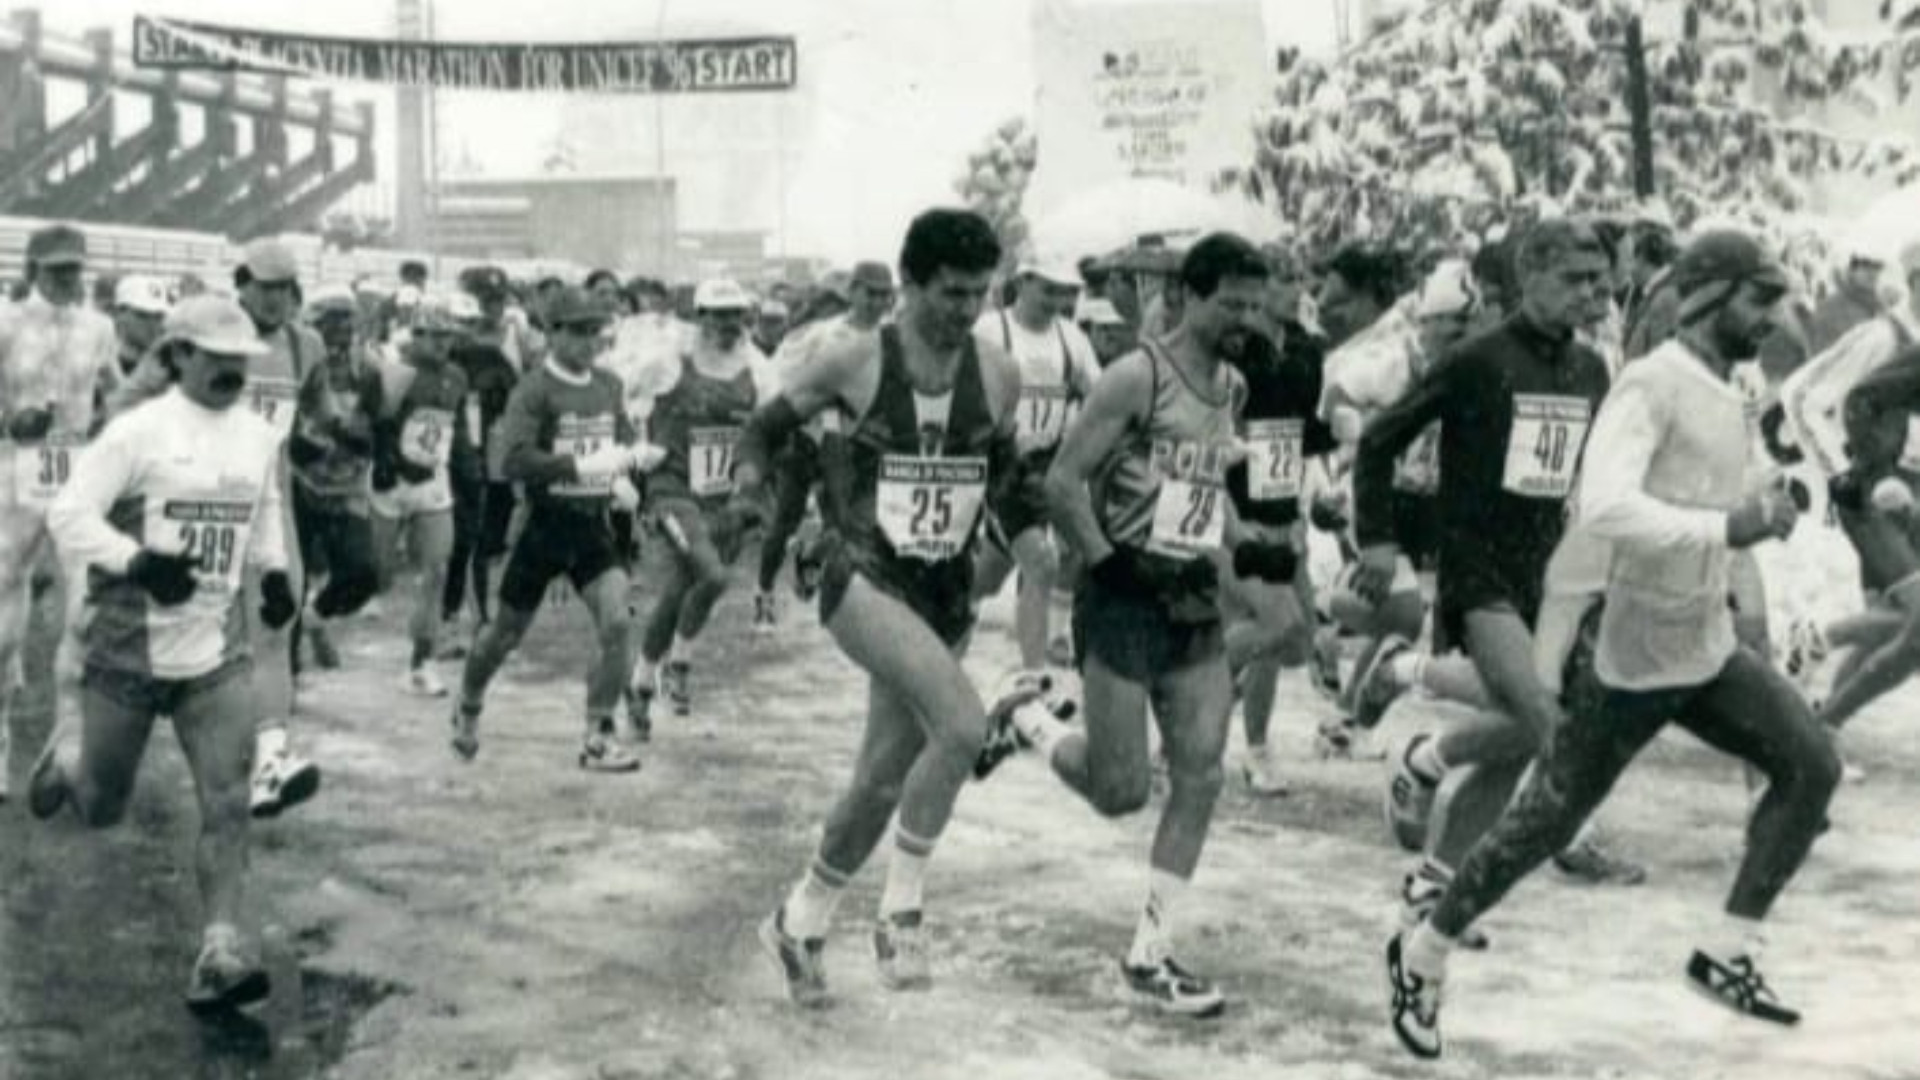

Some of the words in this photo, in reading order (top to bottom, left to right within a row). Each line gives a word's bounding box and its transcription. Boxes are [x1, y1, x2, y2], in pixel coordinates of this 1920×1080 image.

[378, 48, 508, 86] MARATHON
[522, 50, 564, 89] FOR
[701, 44, 787, 83] START
[910, 486, 953, 536] 25
[179, 524, 235, 575] 289
